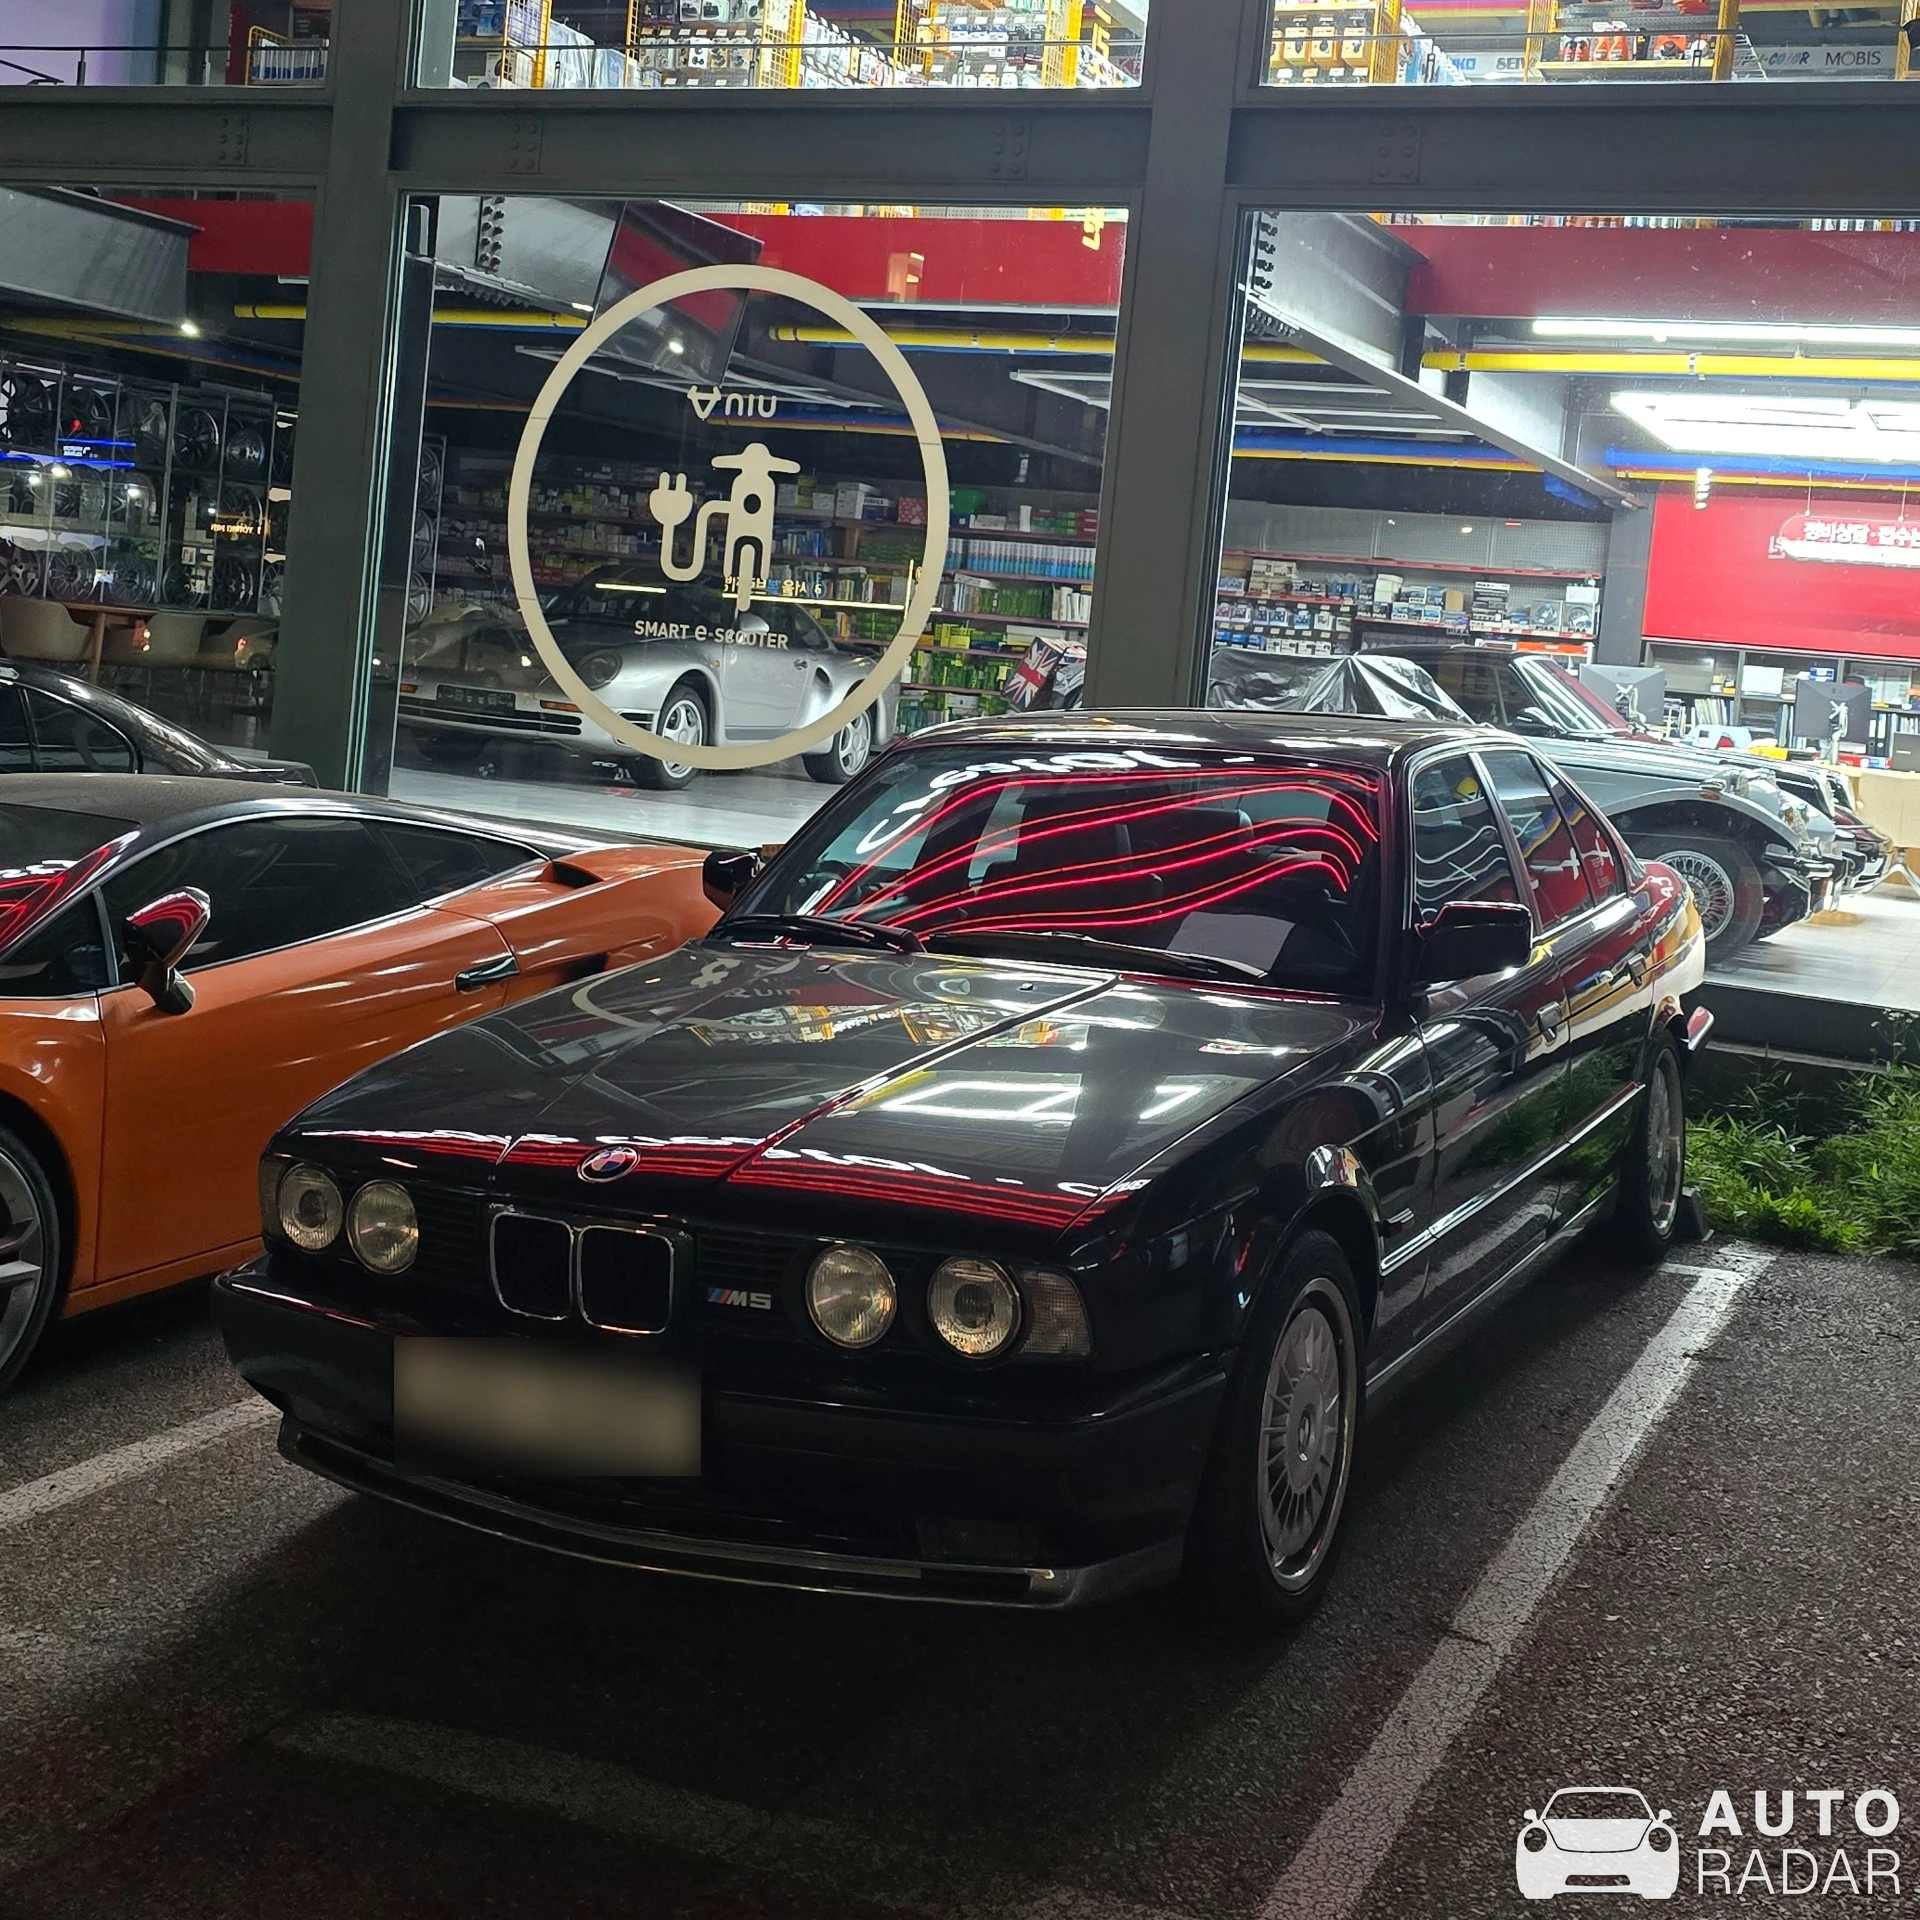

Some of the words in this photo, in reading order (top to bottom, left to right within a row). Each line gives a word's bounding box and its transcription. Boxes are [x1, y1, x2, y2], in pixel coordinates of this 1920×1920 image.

[1825, 50, 1882, 66] MOBIS
[634, 620, 689, 639] SMART
[1535, 624, 1555, 632] PIAA
[726, 1290, 772, 1310] M5
